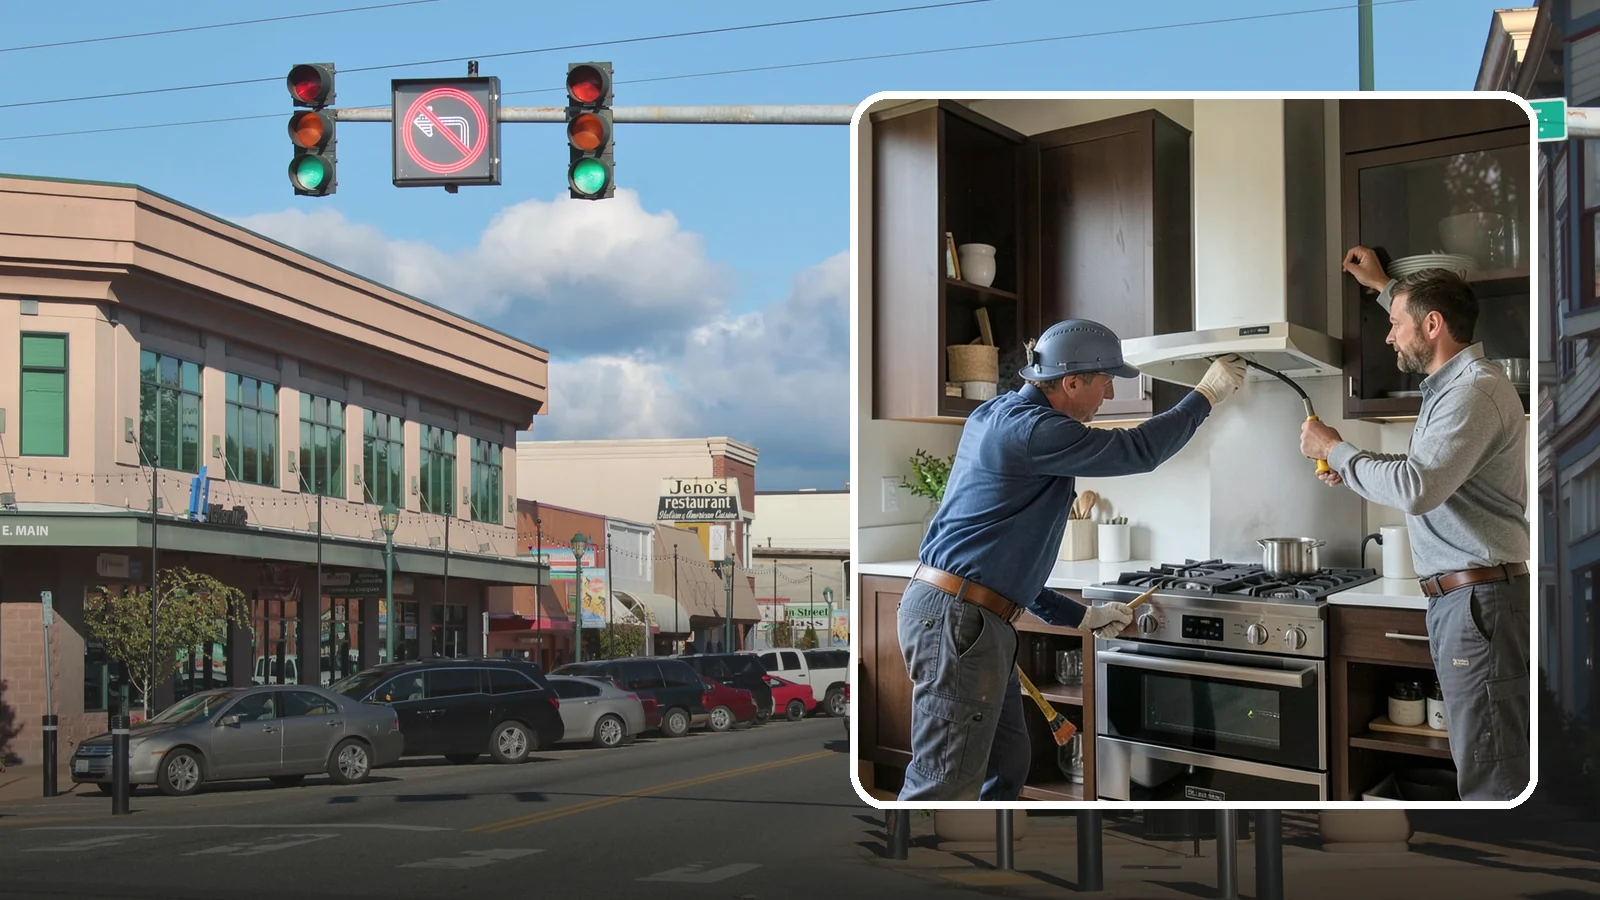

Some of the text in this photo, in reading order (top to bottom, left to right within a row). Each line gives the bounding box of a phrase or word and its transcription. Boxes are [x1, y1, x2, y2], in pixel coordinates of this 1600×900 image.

[670, 480, 727, 494] Jeno's
[665, 496, 731, 509] restaurant
[659, 510, 681, 519] Italian
[686, 510, 715, 519] American
[715, 510, 737, 519] Cuisine
[2, 525, 49, 536] E. MAIN
[797, 607, 828, 617] Street
[790, 619, 823, 627] lass
